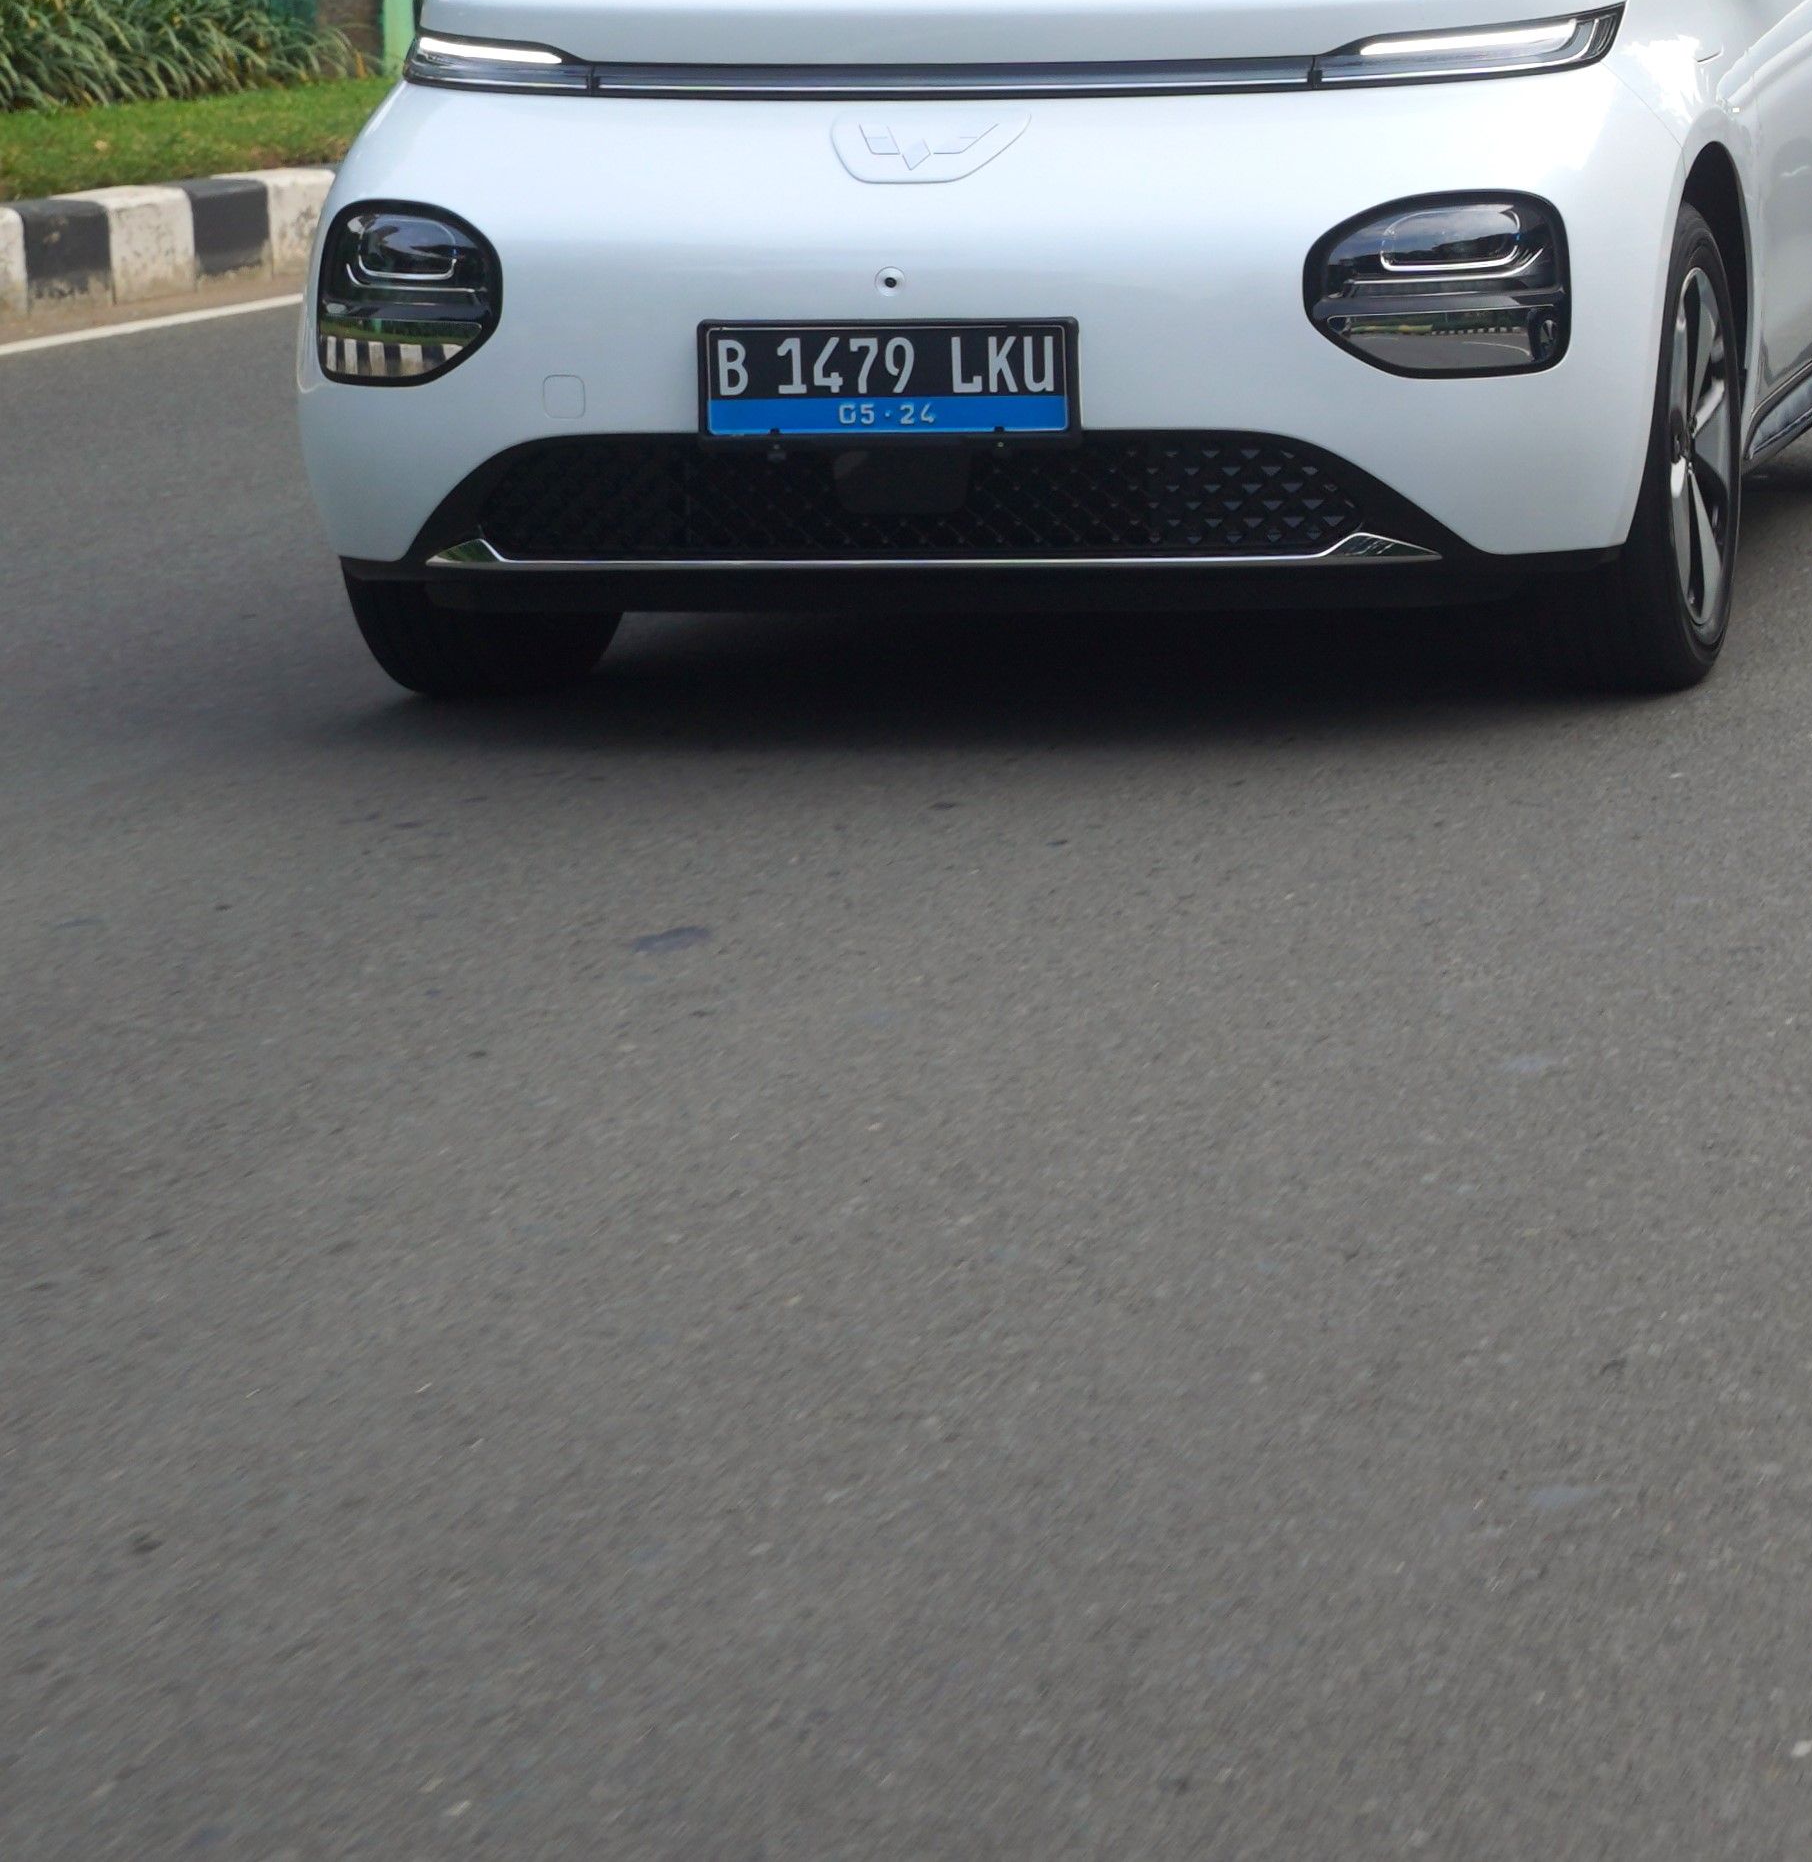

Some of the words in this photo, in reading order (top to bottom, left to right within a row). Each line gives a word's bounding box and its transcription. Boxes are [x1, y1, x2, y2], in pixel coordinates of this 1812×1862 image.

[716, 339, 749, 397] B
[776, 336, 915, 395] 1479
[950, 336, 1055, 394] LKU
